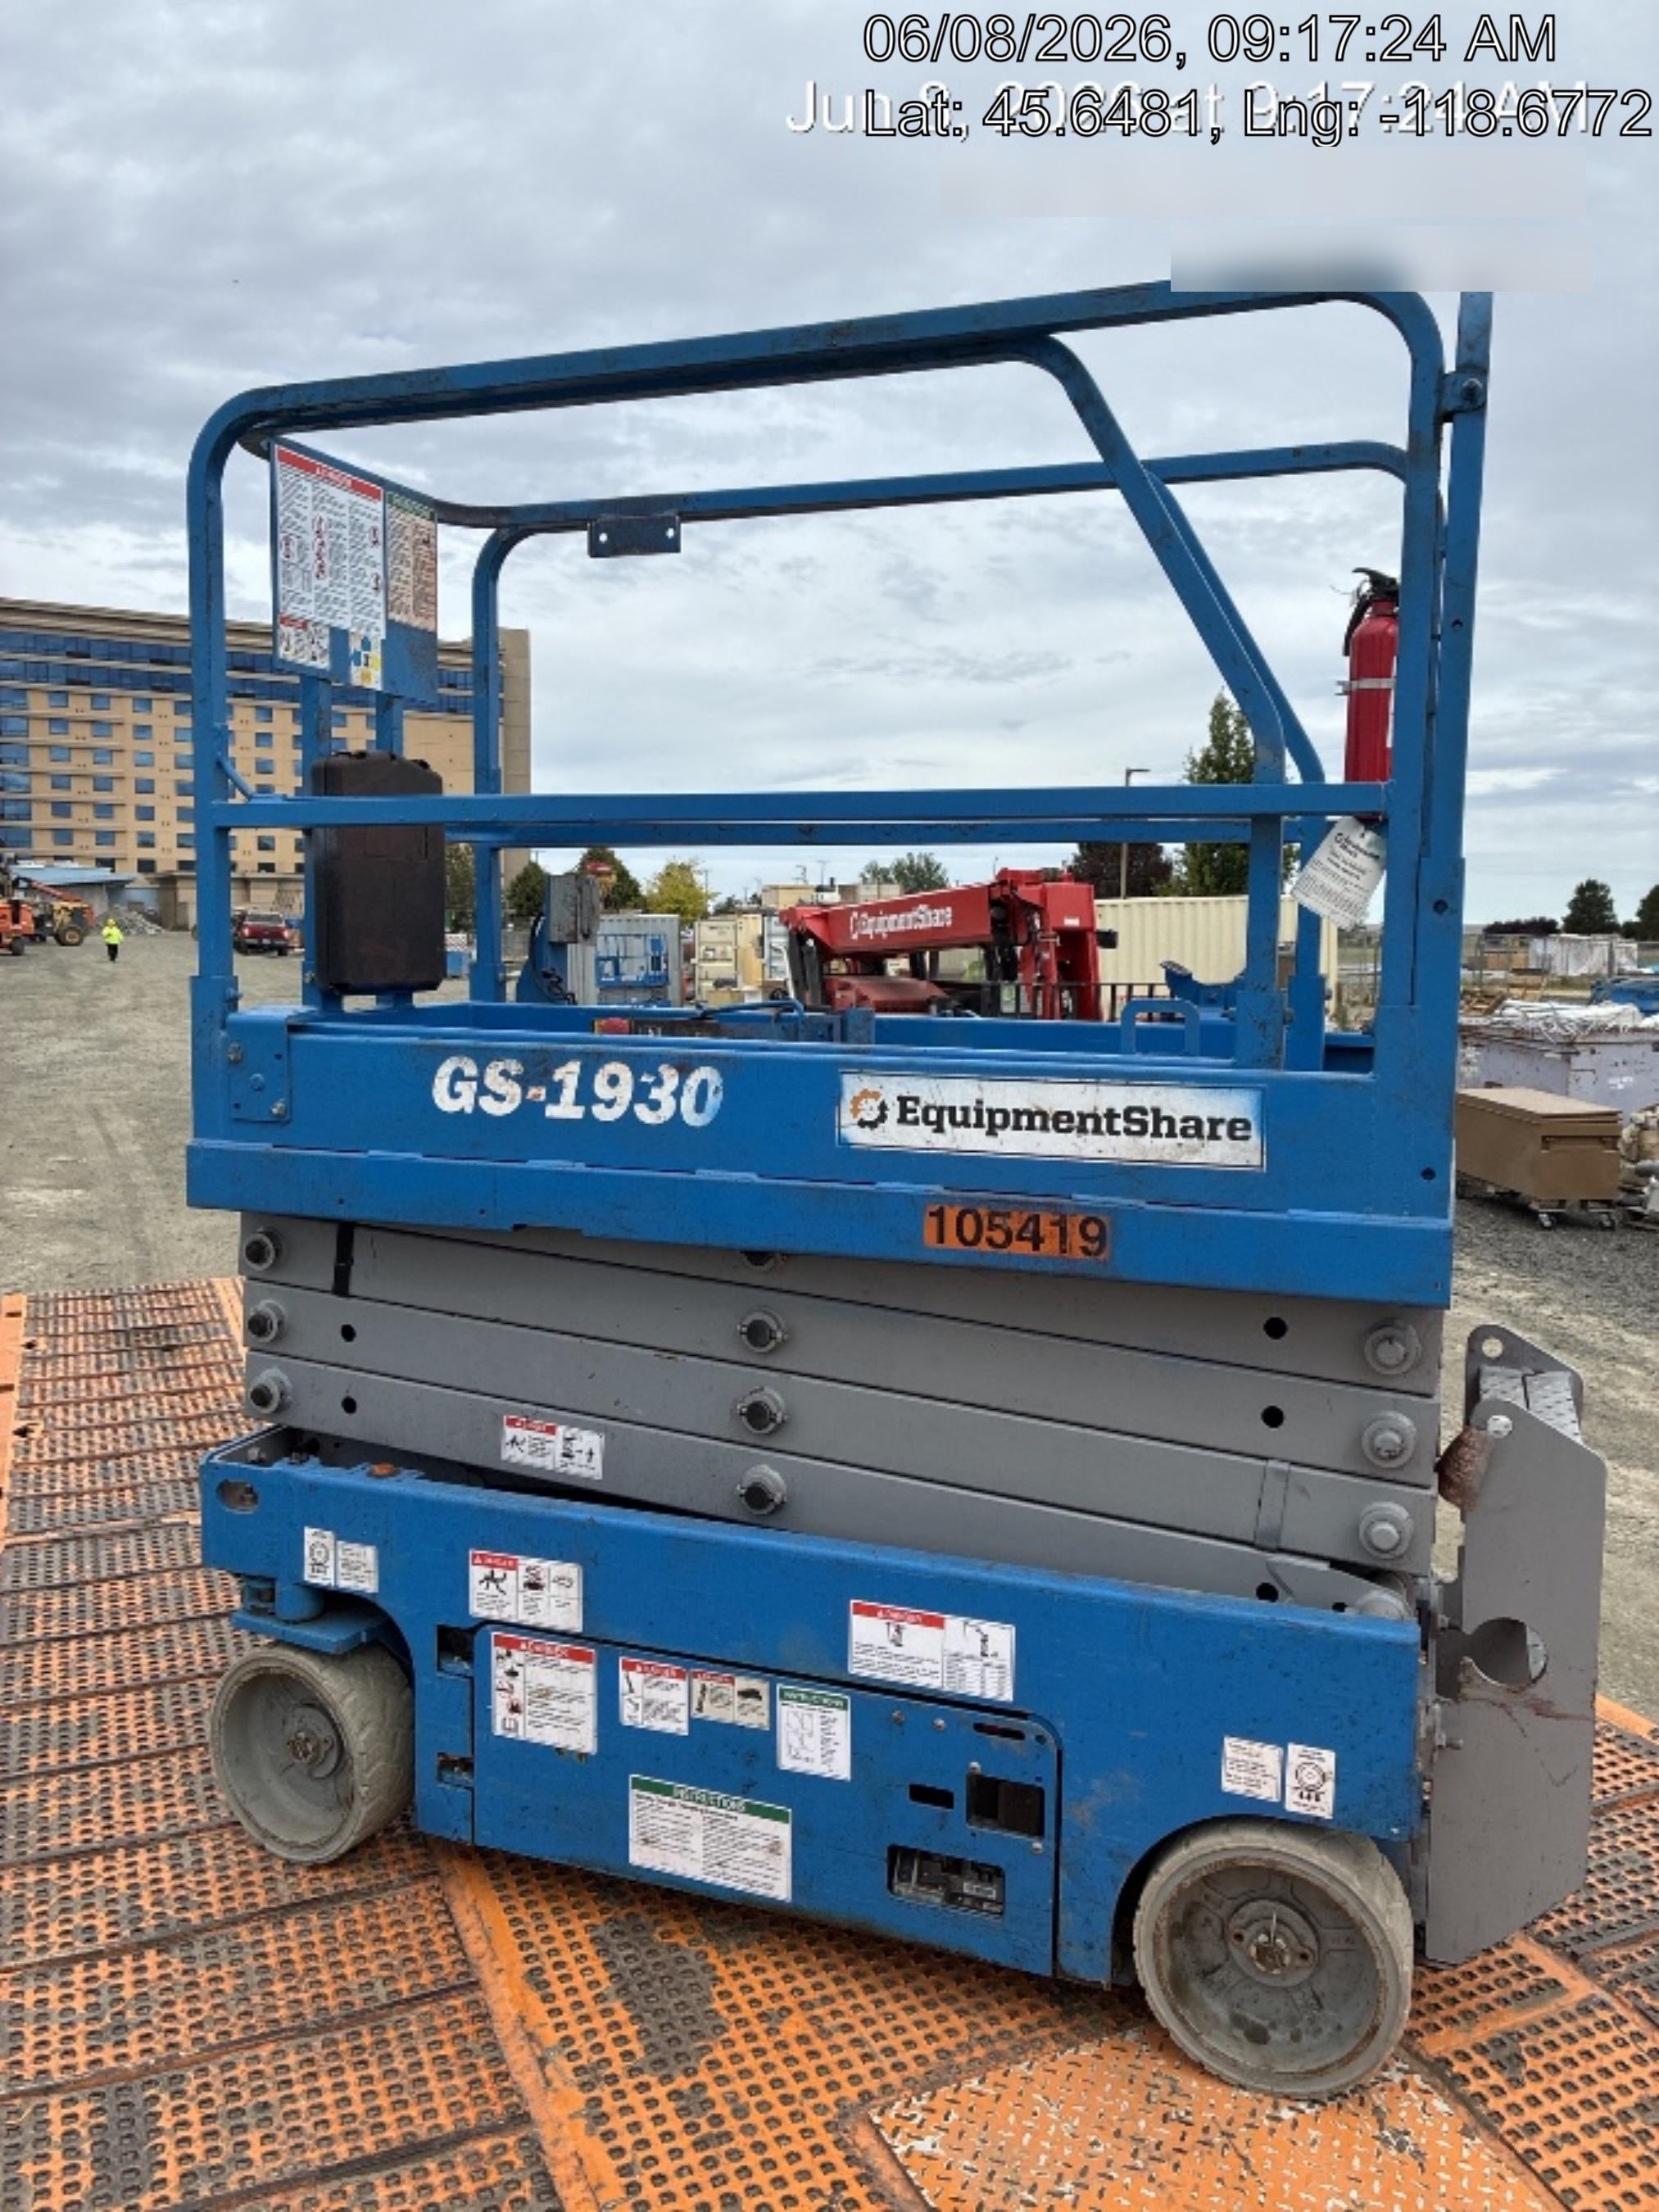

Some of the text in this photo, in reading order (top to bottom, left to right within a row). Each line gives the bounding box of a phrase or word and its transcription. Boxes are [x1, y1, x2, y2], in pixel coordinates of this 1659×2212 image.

[431, 1055, 724, 1127] GS-1930
[896, 1095, 1253, 1142] EquipmentShare
[928, 1205, 1108, 1258] 105419
